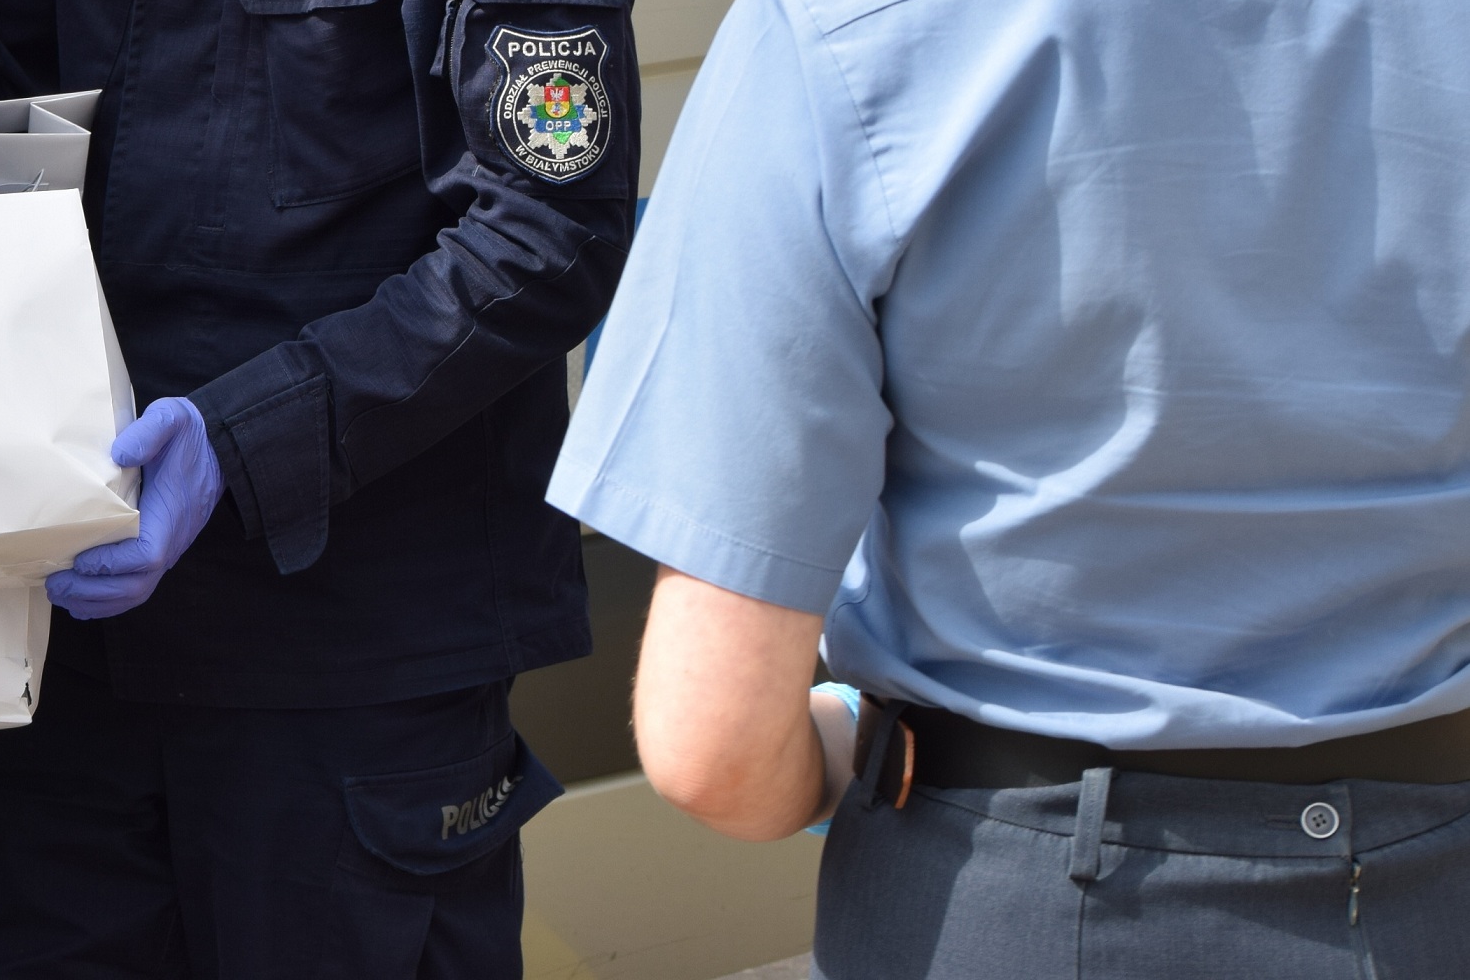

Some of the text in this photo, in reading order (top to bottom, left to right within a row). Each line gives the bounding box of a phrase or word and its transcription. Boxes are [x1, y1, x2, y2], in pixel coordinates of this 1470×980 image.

[508, 41, 597, 57] POLICJA
[503, 59, 608, 120] ODDZIAŁ PREWENCJI POLICJI
[545, 120, 571, 131] OPP
[515, 144, 601, 172] W BIAŁYMSTOKU
